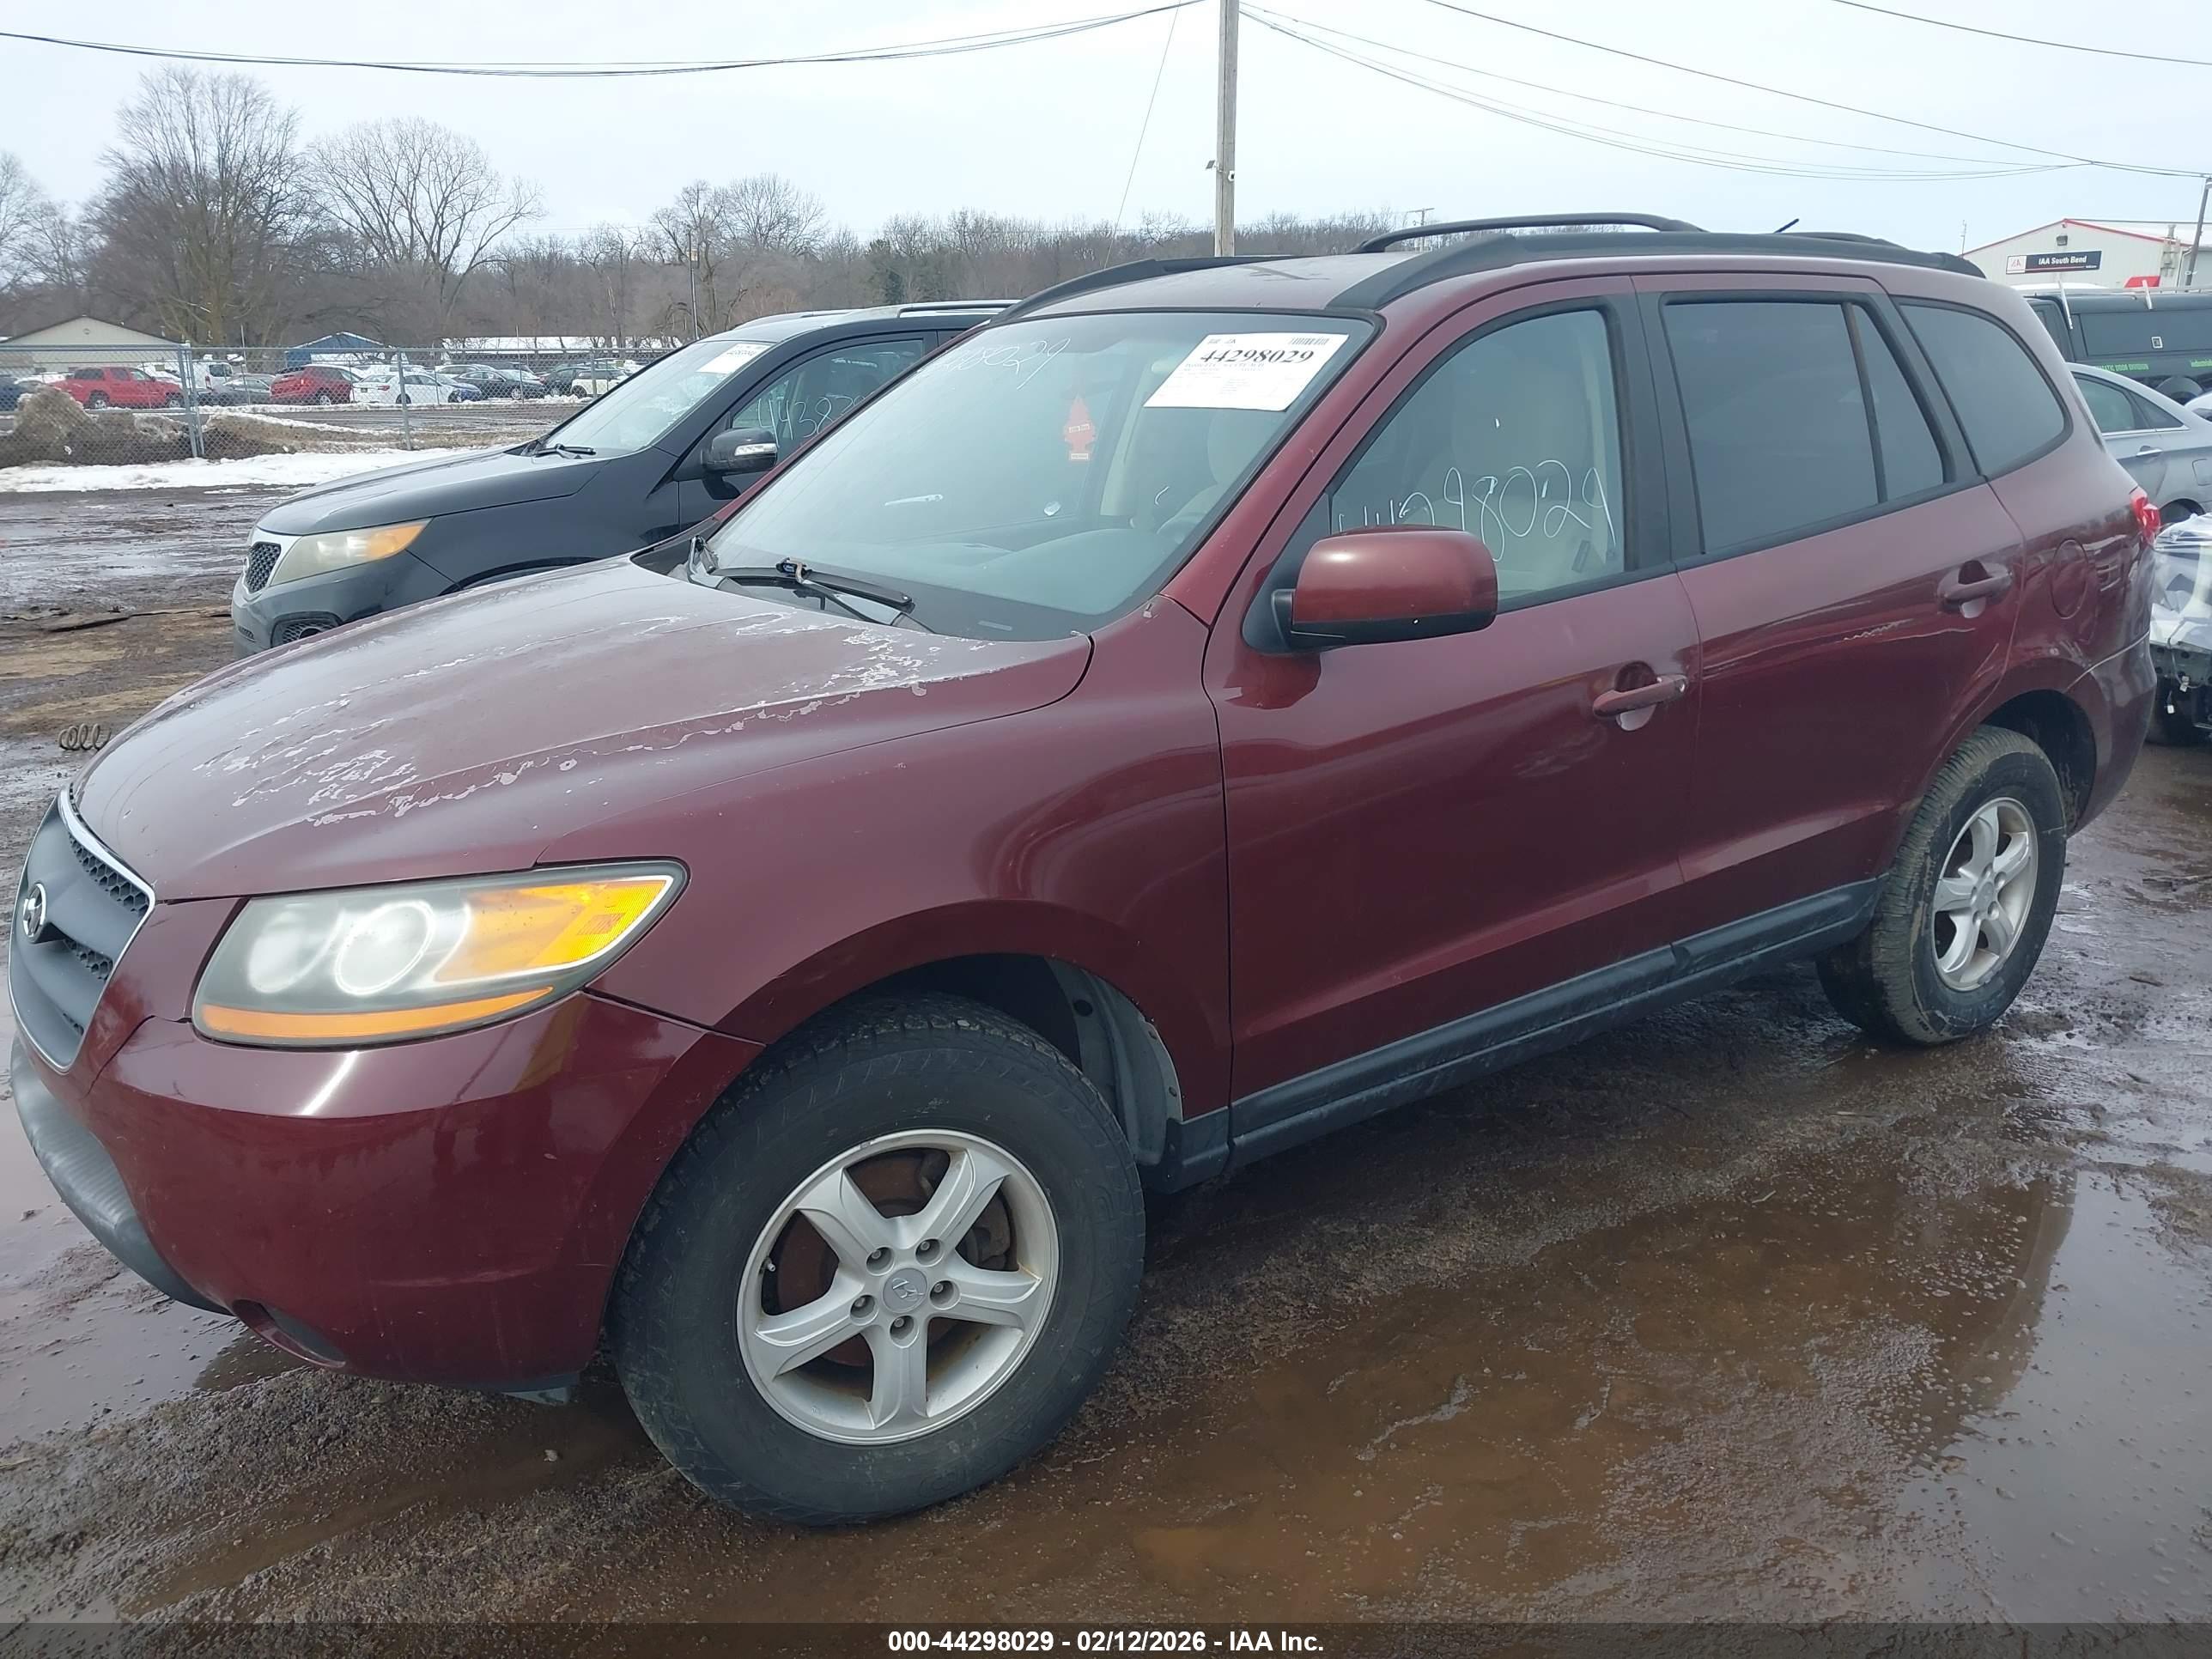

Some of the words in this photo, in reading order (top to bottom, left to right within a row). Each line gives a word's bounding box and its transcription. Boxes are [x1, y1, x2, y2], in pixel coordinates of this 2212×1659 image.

[2051, 256, 2069, 265] South
[2070, 255, 2087, 264] Bend
[1200, 349, 1315, 363] 44298029
